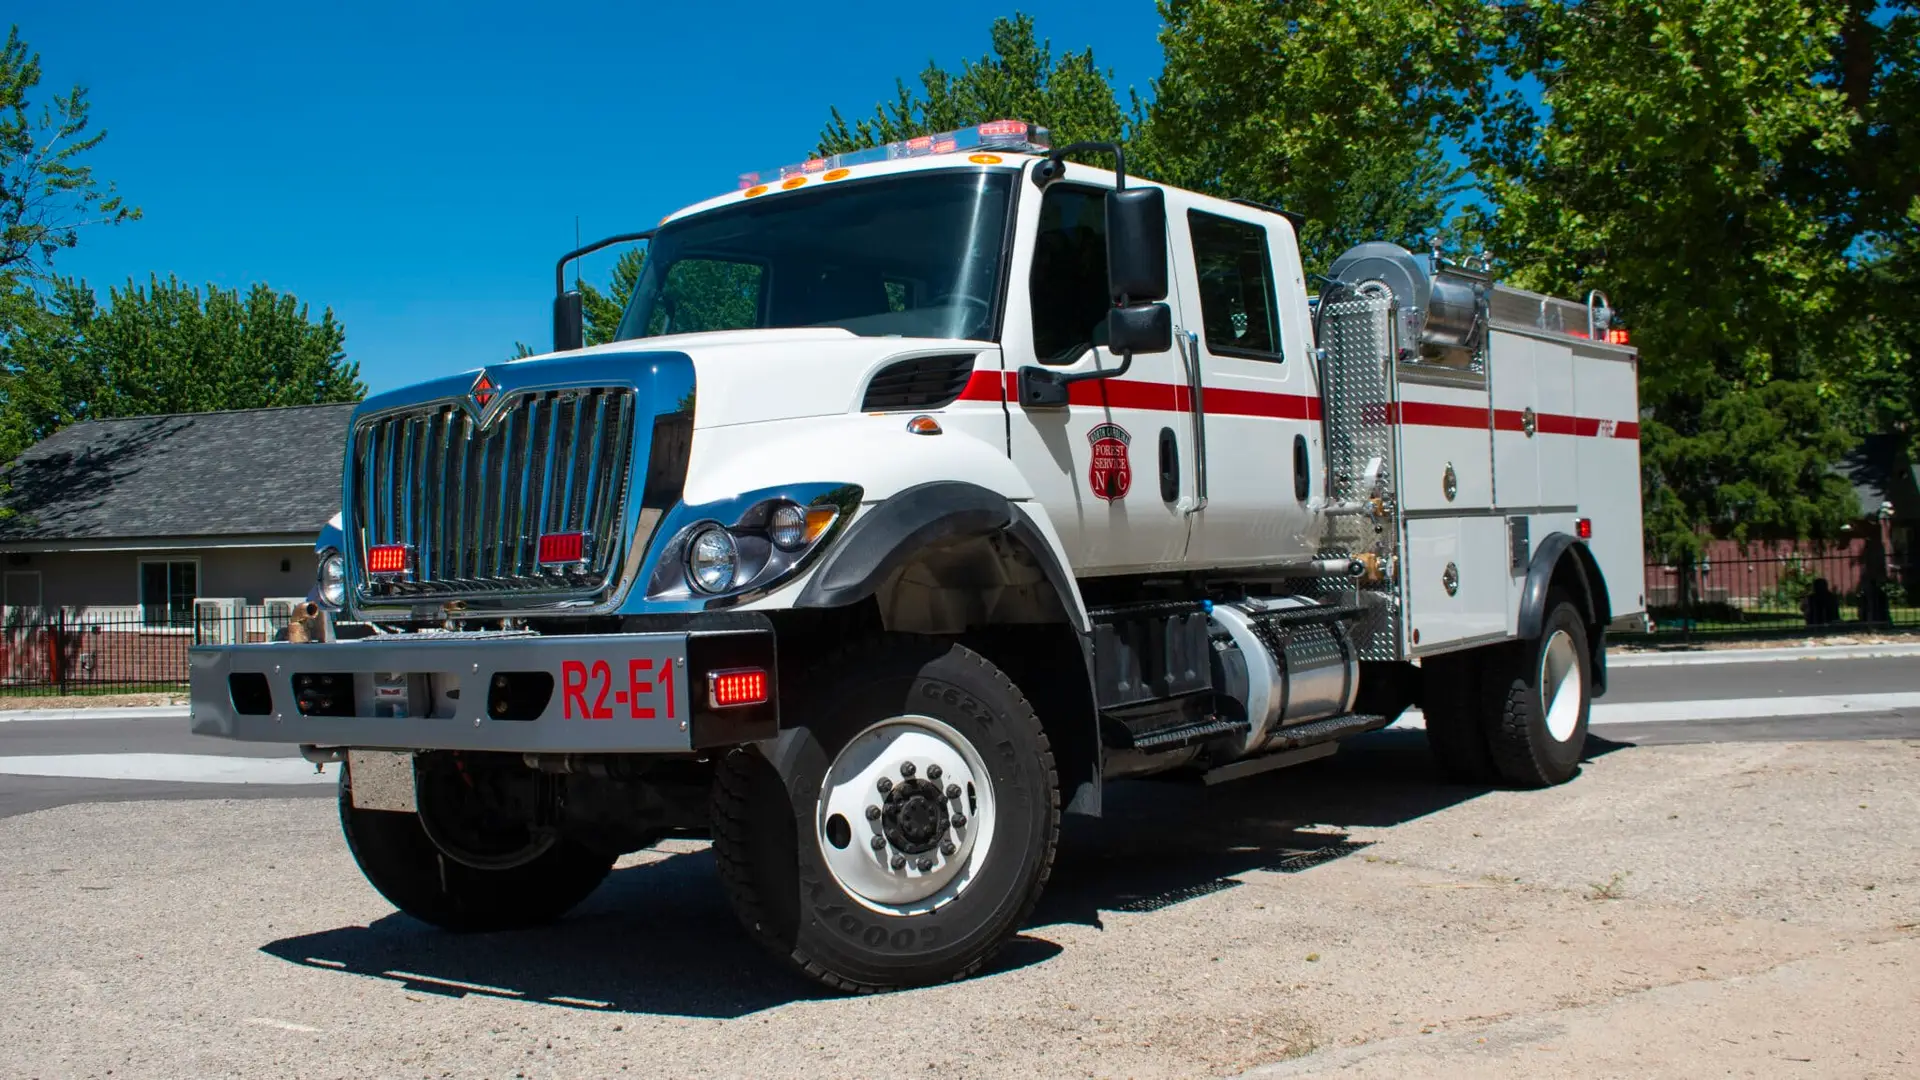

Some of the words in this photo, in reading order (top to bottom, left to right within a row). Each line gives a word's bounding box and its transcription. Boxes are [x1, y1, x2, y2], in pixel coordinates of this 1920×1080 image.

[1095, 445, 1125, 456] FOREST
[1095, 458, 1127, 469] SERVICE
[1095, 471, 1106, 490] N
[1118, 471, 1127, 490] C
[561, 658, 675, 720] R2-E1
[921, 682, 993, 734] G622
